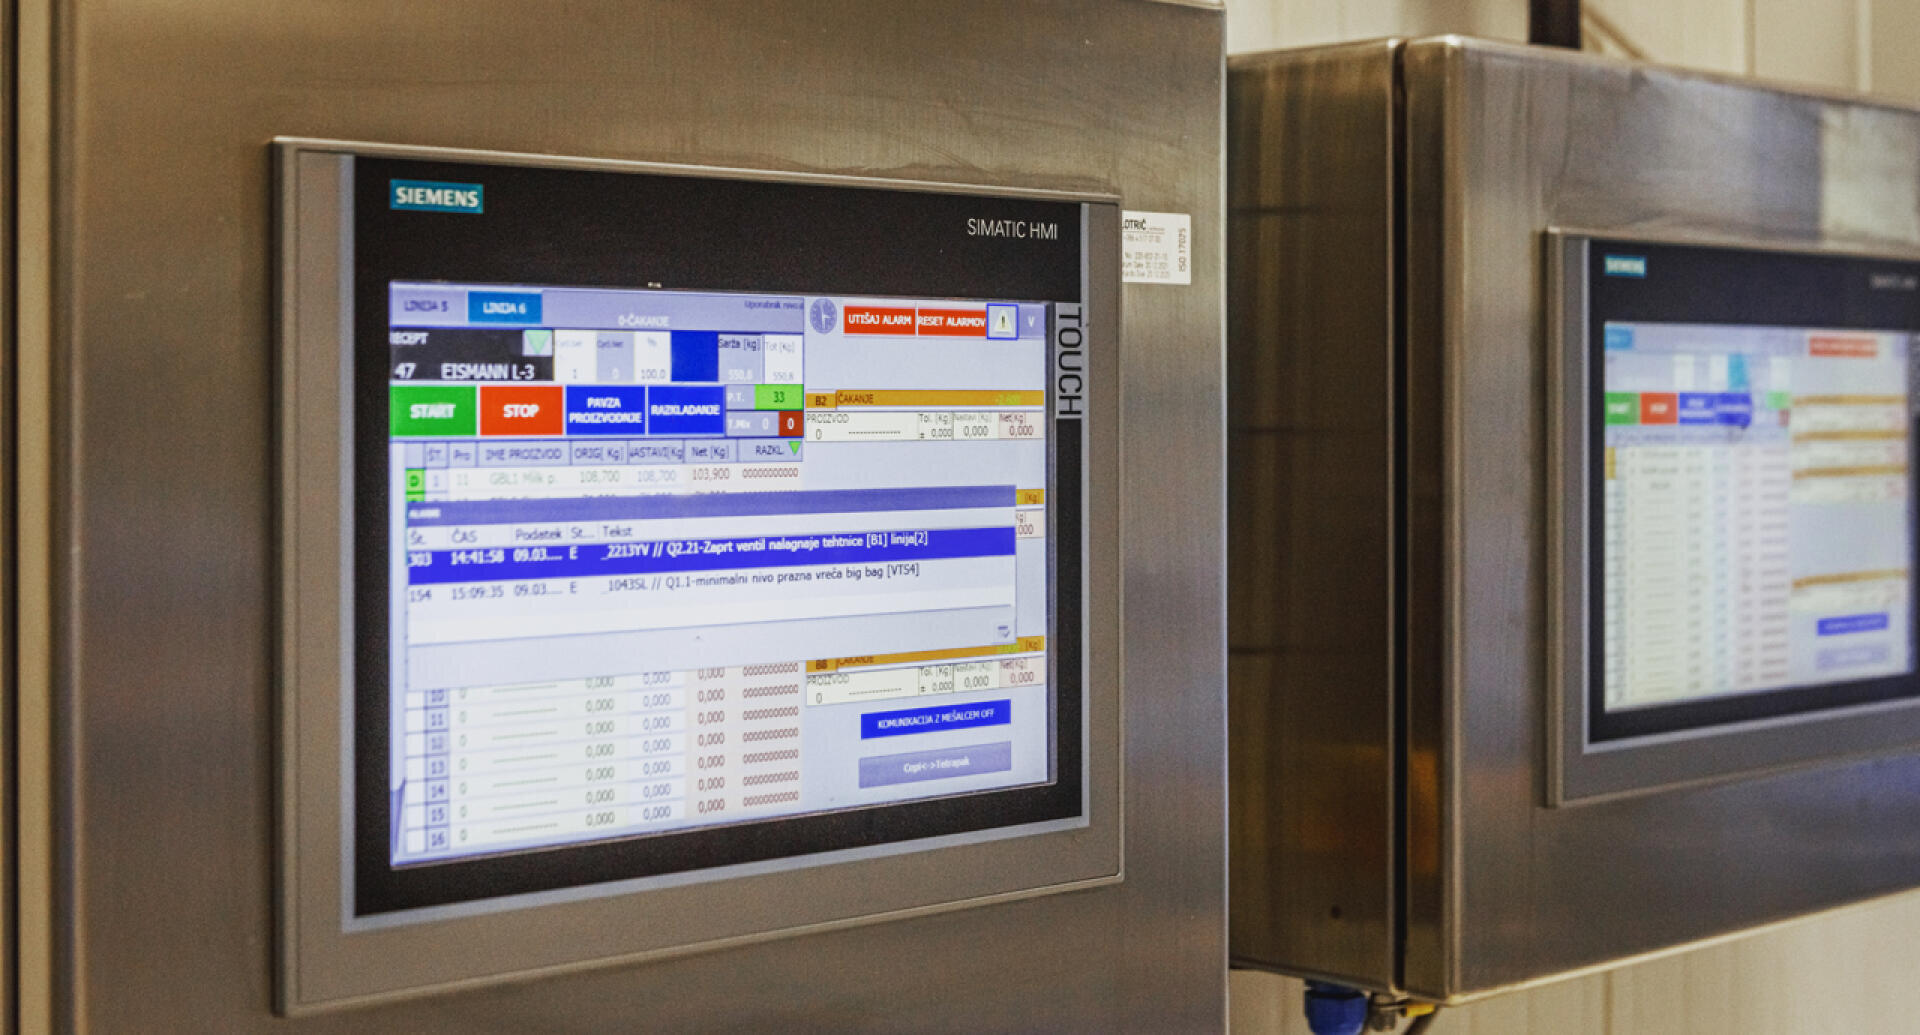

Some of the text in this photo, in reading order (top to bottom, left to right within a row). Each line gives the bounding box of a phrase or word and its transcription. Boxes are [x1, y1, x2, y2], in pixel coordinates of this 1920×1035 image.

[395, 187, 479, 208] SIEMENS
[967, 218, 1057, 240] SIMATIC HMI
[848, 312, 913, 326] UTIŠAJ ALARM
[917, 316, 987, 329] RESET ALARMOV
[1058, 307, 1083, 416] TOUCH
[395, 362, 536, 381] 47 EISMANN L-3
[588, 396, 622, 410] PAVZA
[773, 391, 786, 404] 33
[815, 395, 827, 407] B2
[411, 404, 456, 420] START
[503, 404, 541, 419] STOP
[650, 404, 721, 417] RAZKLADANJE
[787, 418, 796, 431] 0
[963, 425, 990, 437] 0,000
[1009, 424, 1035, 437] 0,000
[815, 429, 823, 441] 0
[451, 528, 478, 544] ČAS
[603, 525, 633, 538] Tekst
[451, 549, 505, 566] 14:41:58
[570, 544, 579, 560] E
[652, 541, 664, 558] //
[736, 537, 767, 554] ventil
[822, 533, 864, 549] tehtnice
[569, 580, 578, 595] E
[752, 571, 775, 584] nivo
[777, 570, 813, 585] prazna
[815, 567, 844, 581] vreča
[846, 563, 863, 579] big
[865, 563, 884, 579] bag
[698, 667, 725, 681] 0,000
[1010, 672, 1036, 685] 0,000
[964, 675, 990, 689] 0,000
[698, 689, 725, 703] 0,000
[815, 692, 824, 704] 0
[698, 711, 725, 726] 0,000
[698, 733, 725, 747] 0,000
[698, 755, 725, 769] 0,000
[698, 777, 725, 791] 0,000
[698, 798, 725, 813] 0,000
